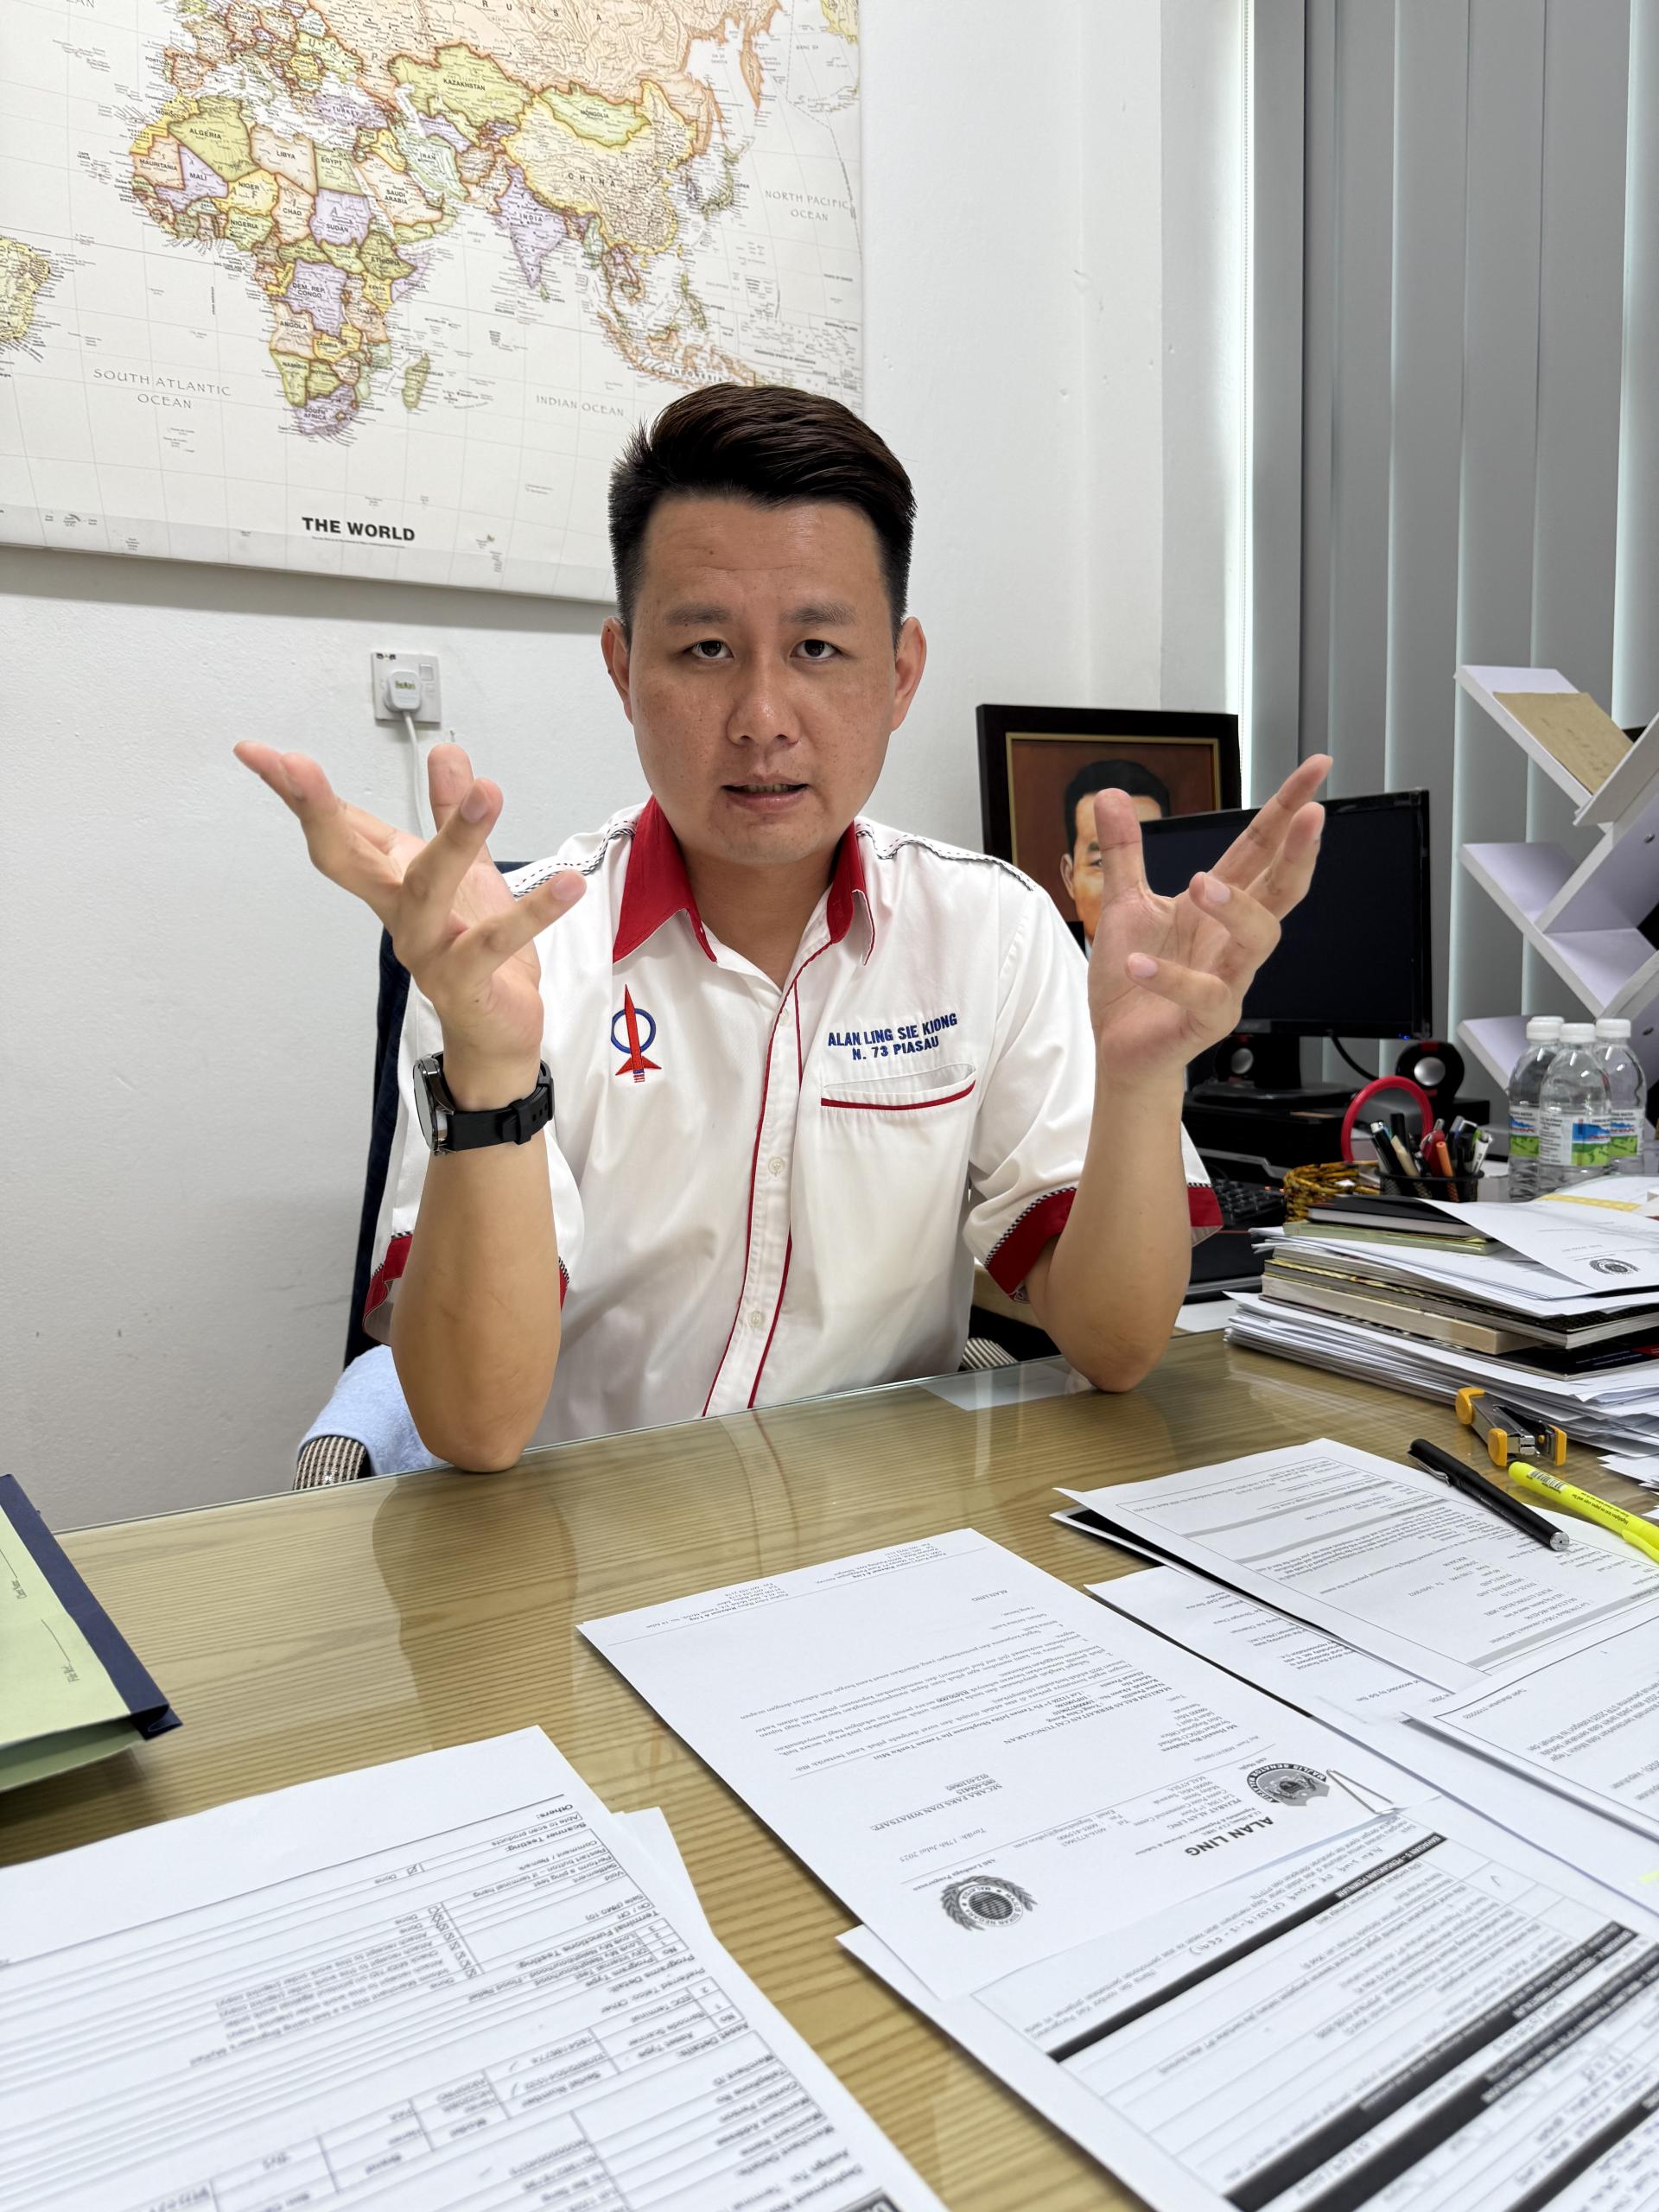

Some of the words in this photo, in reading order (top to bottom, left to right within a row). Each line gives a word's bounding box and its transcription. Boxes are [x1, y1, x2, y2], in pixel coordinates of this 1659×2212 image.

[442, 78, 486, 92] KAZAKHSTAN
[156, 109, 186, 120] MOROCCO
[580, 109, 609, 119] MONGOLIA
[189, 128, 222, 140] ALGERIA
[276, 150, 296, 160] LIBYA
[321, 156, 343, 167] EGYPT
[420, 152, 436, 161] IRAN
[139, 158, 178, 172] MAURITANIA
[189, 172, 207, 181] MALI
[567, 172, 617, 188] CHINA
[238, 181, 260, 191] NIGER
[385, 195, 408, 205] ARABIA
[386, 189, 406, 198] SAUDI
[765, 190, 804, 203] NORTH
[807, 194, 849, 210] PACIFIC
[283, 207, 302, 217] CHAD
[519, 214, 543, 223] INDIA
[791, 208, 829, 222] OCEAN
[230, 219, 258, 230] NIGERIA
[326, 223, 349, 233] SUDAN
[297, 289, 322, 299] CONGO
[280, 321, 308, 331] ANGOLA
[282, 361, 308, 371] NAMIBIA
[93, 368, 149, 385] SOUTH
[156, 377, 232, 397] ATLANTIC
[137, 393, 192, 409] OCEAN
[536, 395, 578, 410] INDIAN
[582, 402, 624, 417] OCEAN
[302, 517, 341, 534] THE
[346, 521, 416, 542] WORLD
[828, 1032, 861, 1046] ALAN
[864, 1028, 893, 1045] LING
[897, 1025, 918, 1040] SIE
[922, 1013, 957, 1036] KIONG
[852, 1048, 867, 1060] N.
[871, 1046, 889, 1058] 73
[893, 1035, 939, 1055] PIASAU
[1292, 1763, 1325, 1780] MAJLIS
[968, 1783, 1002, 1798] SECARA
[944, 1796, 968, 1807] FAKS
[1208, 1798, 1241, 1814] PEJABAT
[536, 1803, 573, 1820] Others:
[924, 1803, 944, 1815] DAN
[1186, 1809, 1207, 1821] ALAN
[559, 1815, 578, 1826] Able
[1166, 1818, 1186, 1829] LING
[1227, 1816, 1274, 1838] ALAN
[528, 1823, 547, 1836] scan
[545, 1821, 586, 1840] Scanner
[491, 1831, 526, 1847] products
[505, 1836, 543, 1853] Testing:
[1185, 1835, 1229, 1856] LING
[556, 1840, 597, 1858] Comment
[575, 1847, 606, 1864] Restart
[518, 1855, 549, 1871] Remark
[577, 1854, 612, 1872] Perform
[899, 1851, 918, 1863] 2025
[546, 1858, 574, 1872] button
[374, 1872, 397, 1885] Done
[550, 1870, 569, 1882] ping
[573, 1862, 617, 1884] Settlement
[604, 1870, 624, 1882] Void
[496, 1874, 530, 1893] terminal
[533, 1878, 550, 1888] test
[624, 1893, 643, 1906] Sale
[614, 1909, 659, 1931] Terminal
[563, 1929, 613, 1953] Functions
[516, 1949, 562, 1970] Testing:
[612, 1956, 653, 1978] Program
[585, 1973, 611, 1988] Type
[661, 1967, 705, 1990] Preferred
[631, 2004, 669, 2023] Terminal
[666, 2010, 706, 2031] Barcode
[721, 2021, 749, 2037] Asset
[628, 2029, 665, 2048] Scanner
